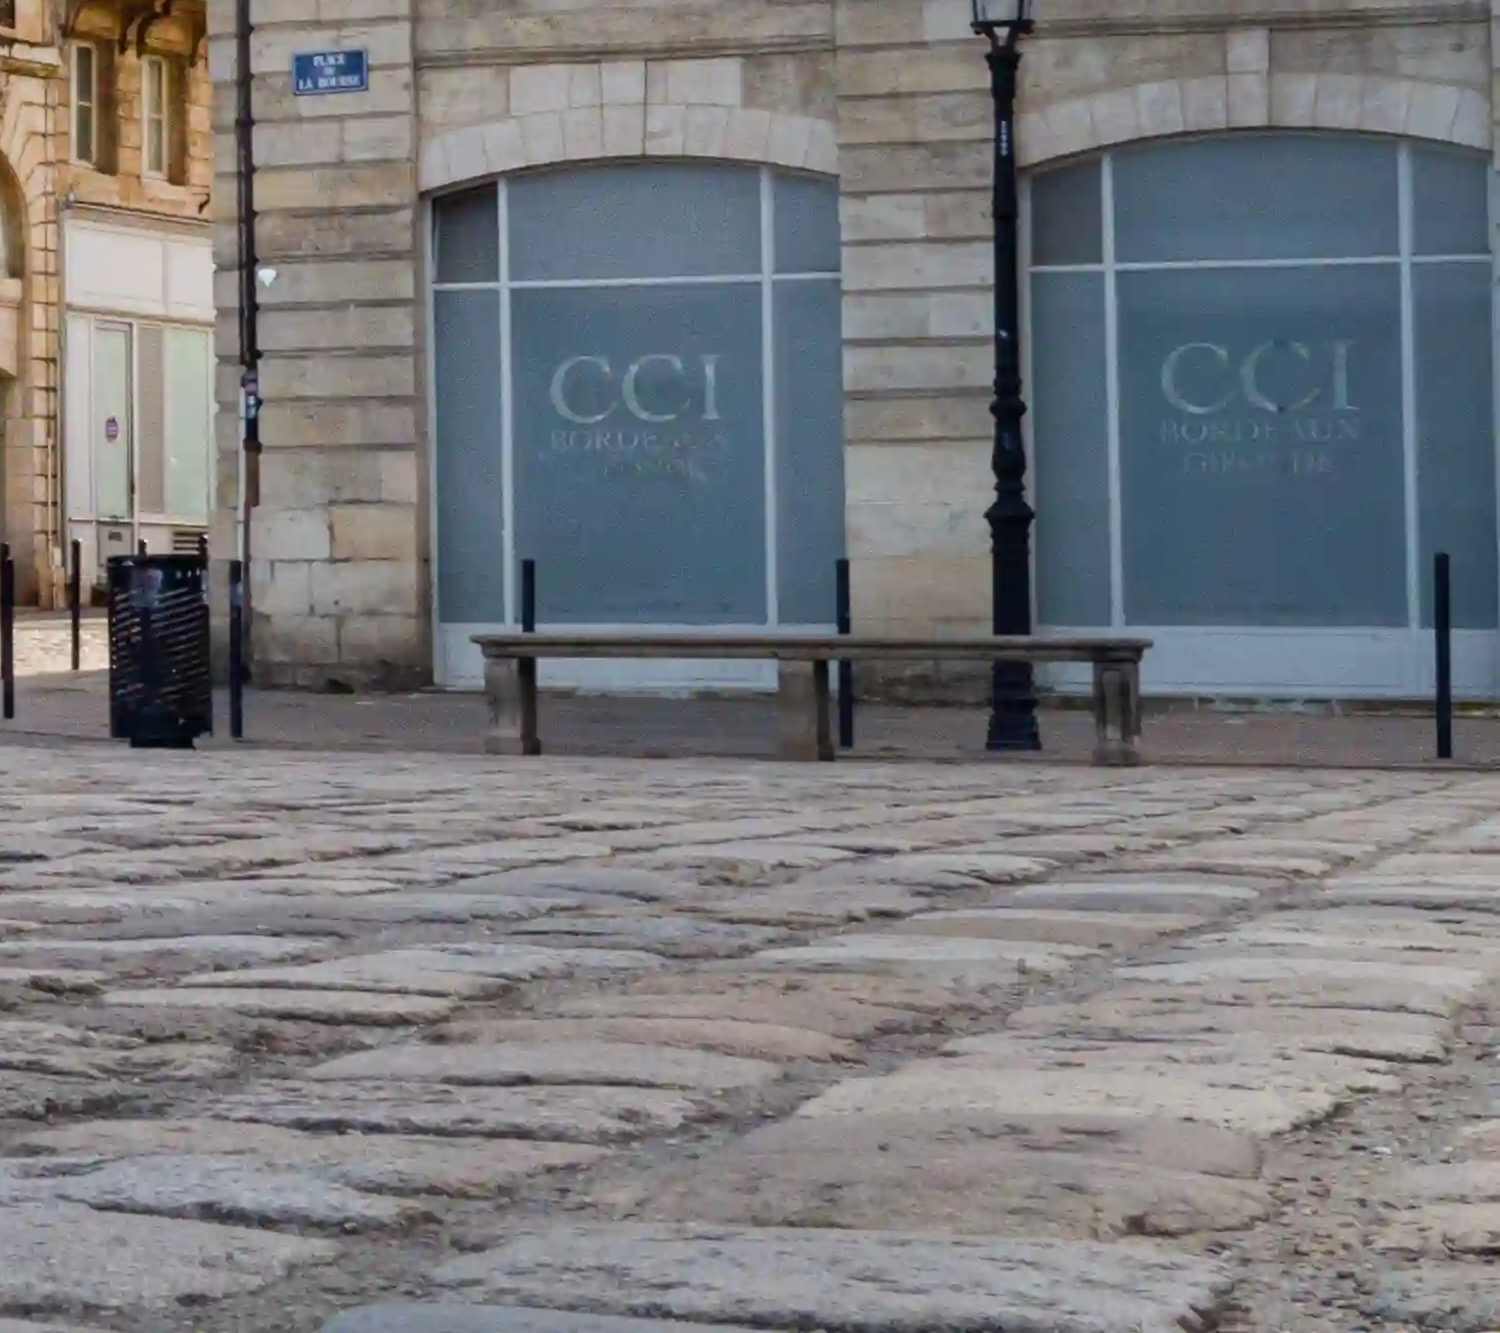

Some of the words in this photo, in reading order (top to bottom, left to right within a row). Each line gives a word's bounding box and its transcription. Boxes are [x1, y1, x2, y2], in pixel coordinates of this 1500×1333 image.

[549, 354, 722, 424] CCI
[1161, 341, 1361, 415] CCI
[550, 429, 729, 451] BORDE
